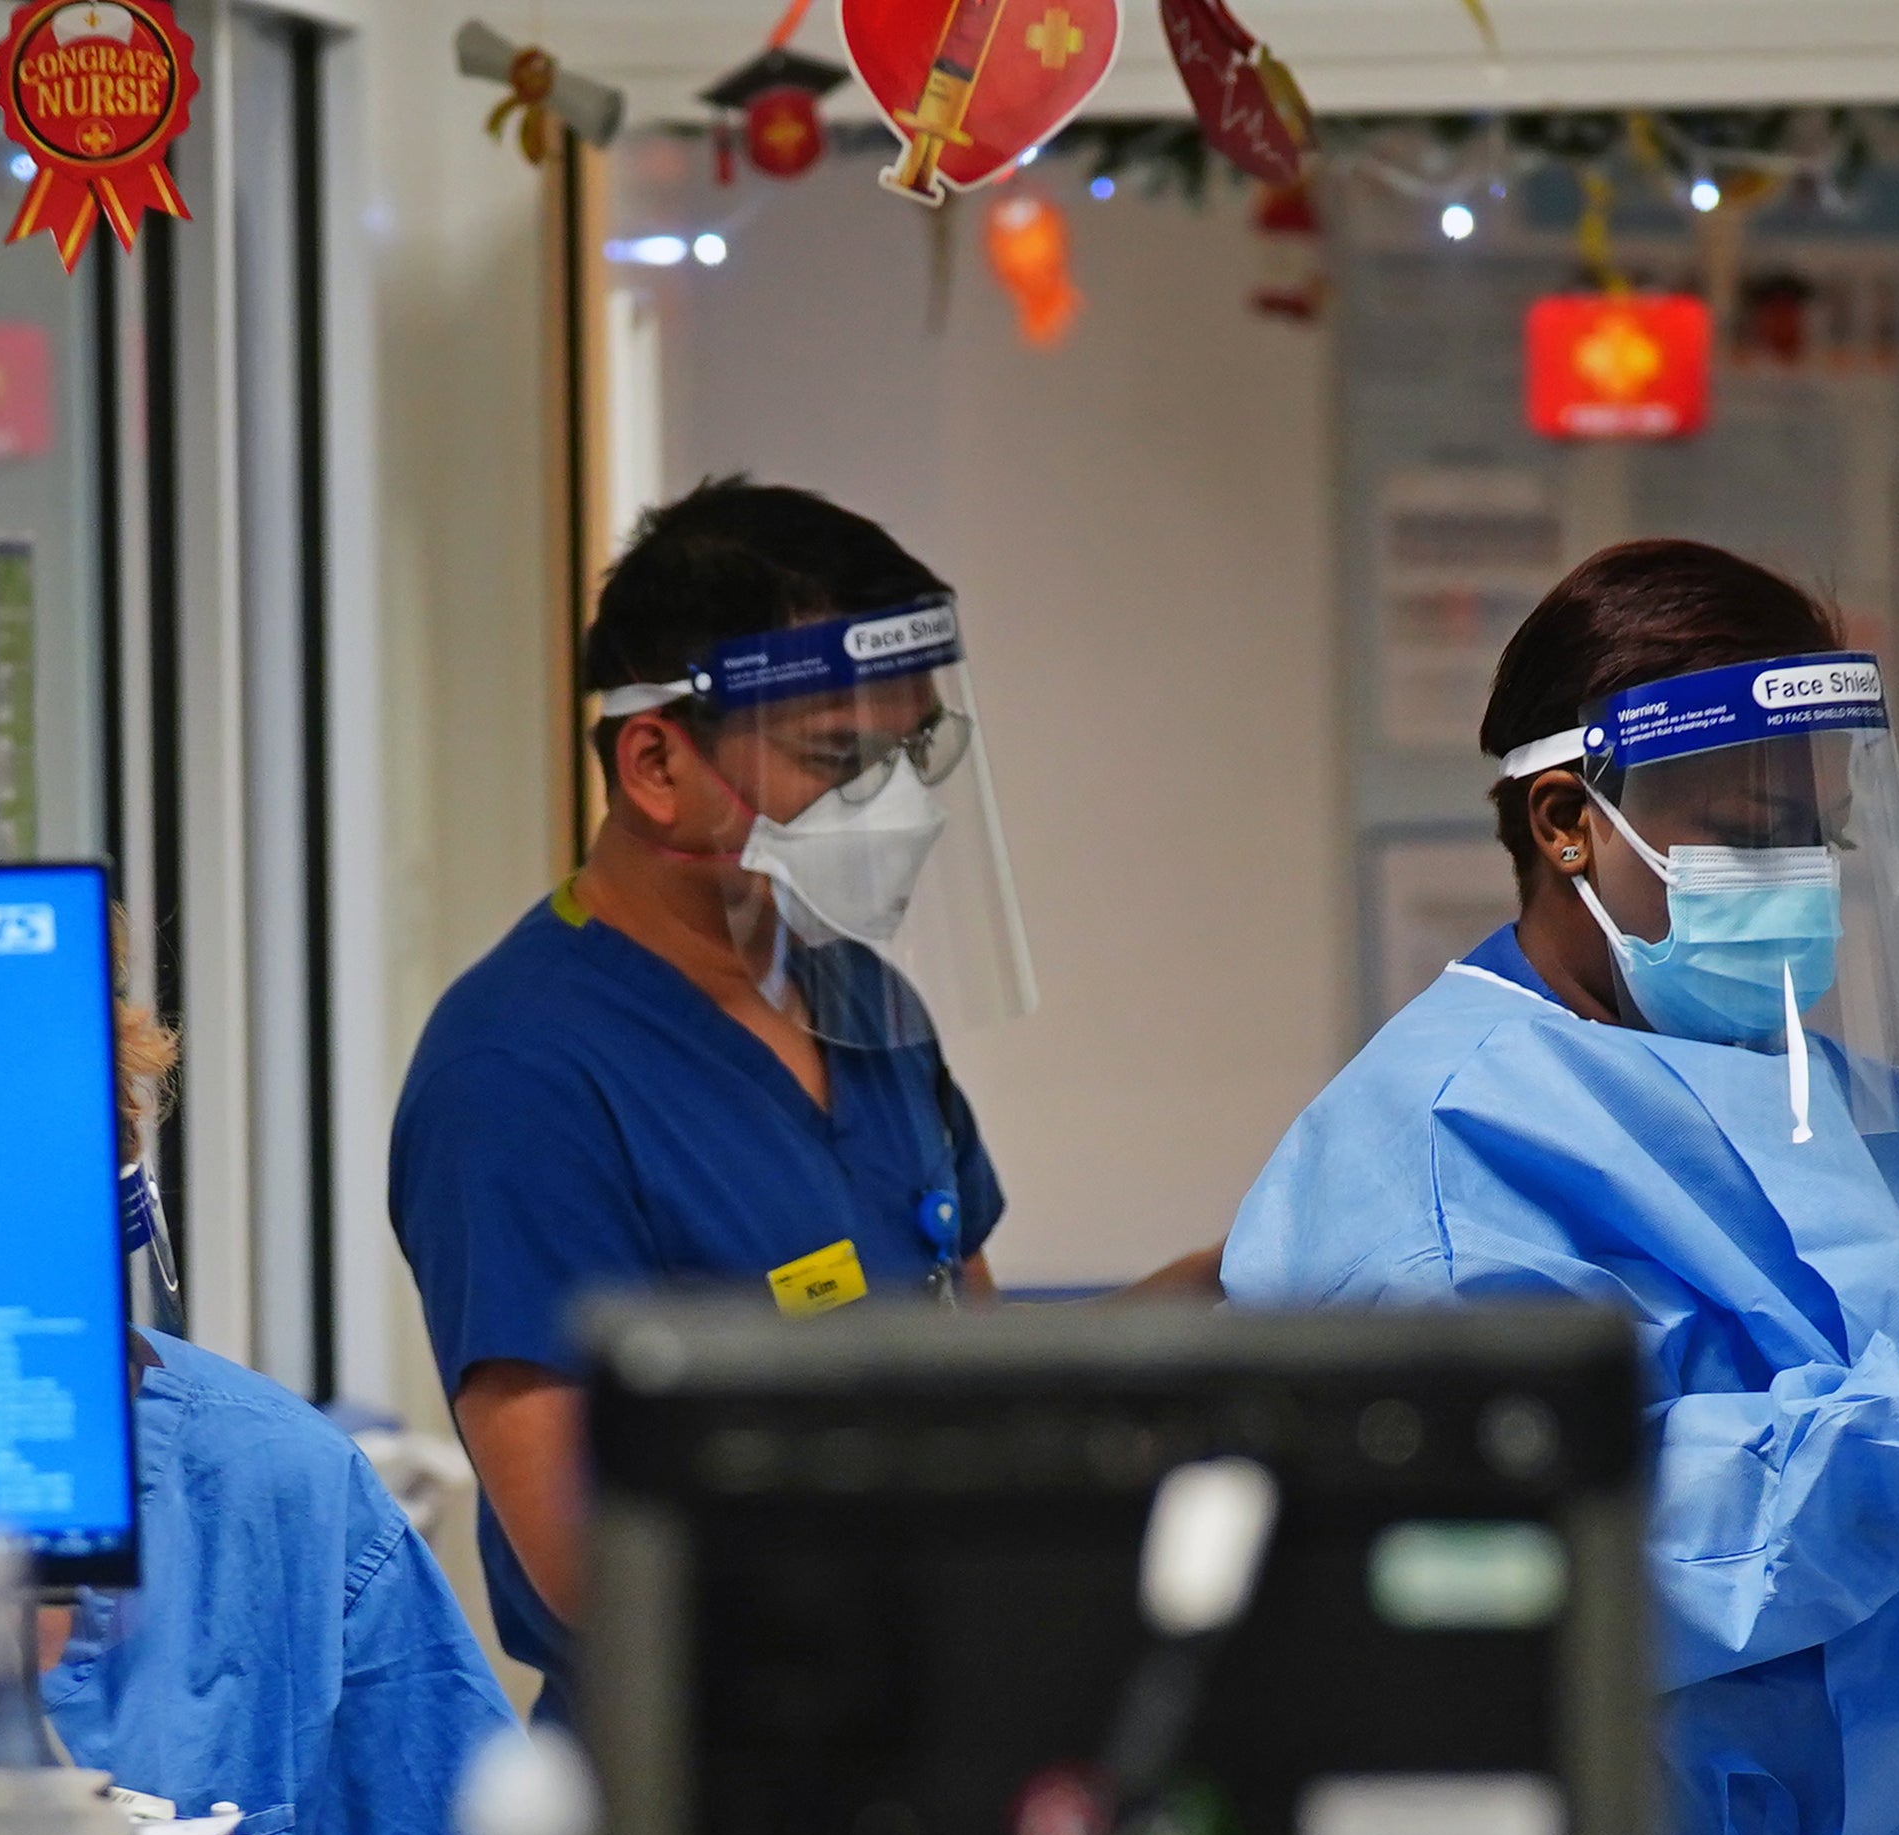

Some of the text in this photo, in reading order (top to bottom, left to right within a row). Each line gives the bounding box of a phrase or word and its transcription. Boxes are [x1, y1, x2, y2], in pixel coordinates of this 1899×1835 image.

[19, 45, 170, 85] CONGRATS
[37, 74, 161, 118] NURSE
[854, 629, 905, 652] Face
[1764, 678, 1824, 701] Face
